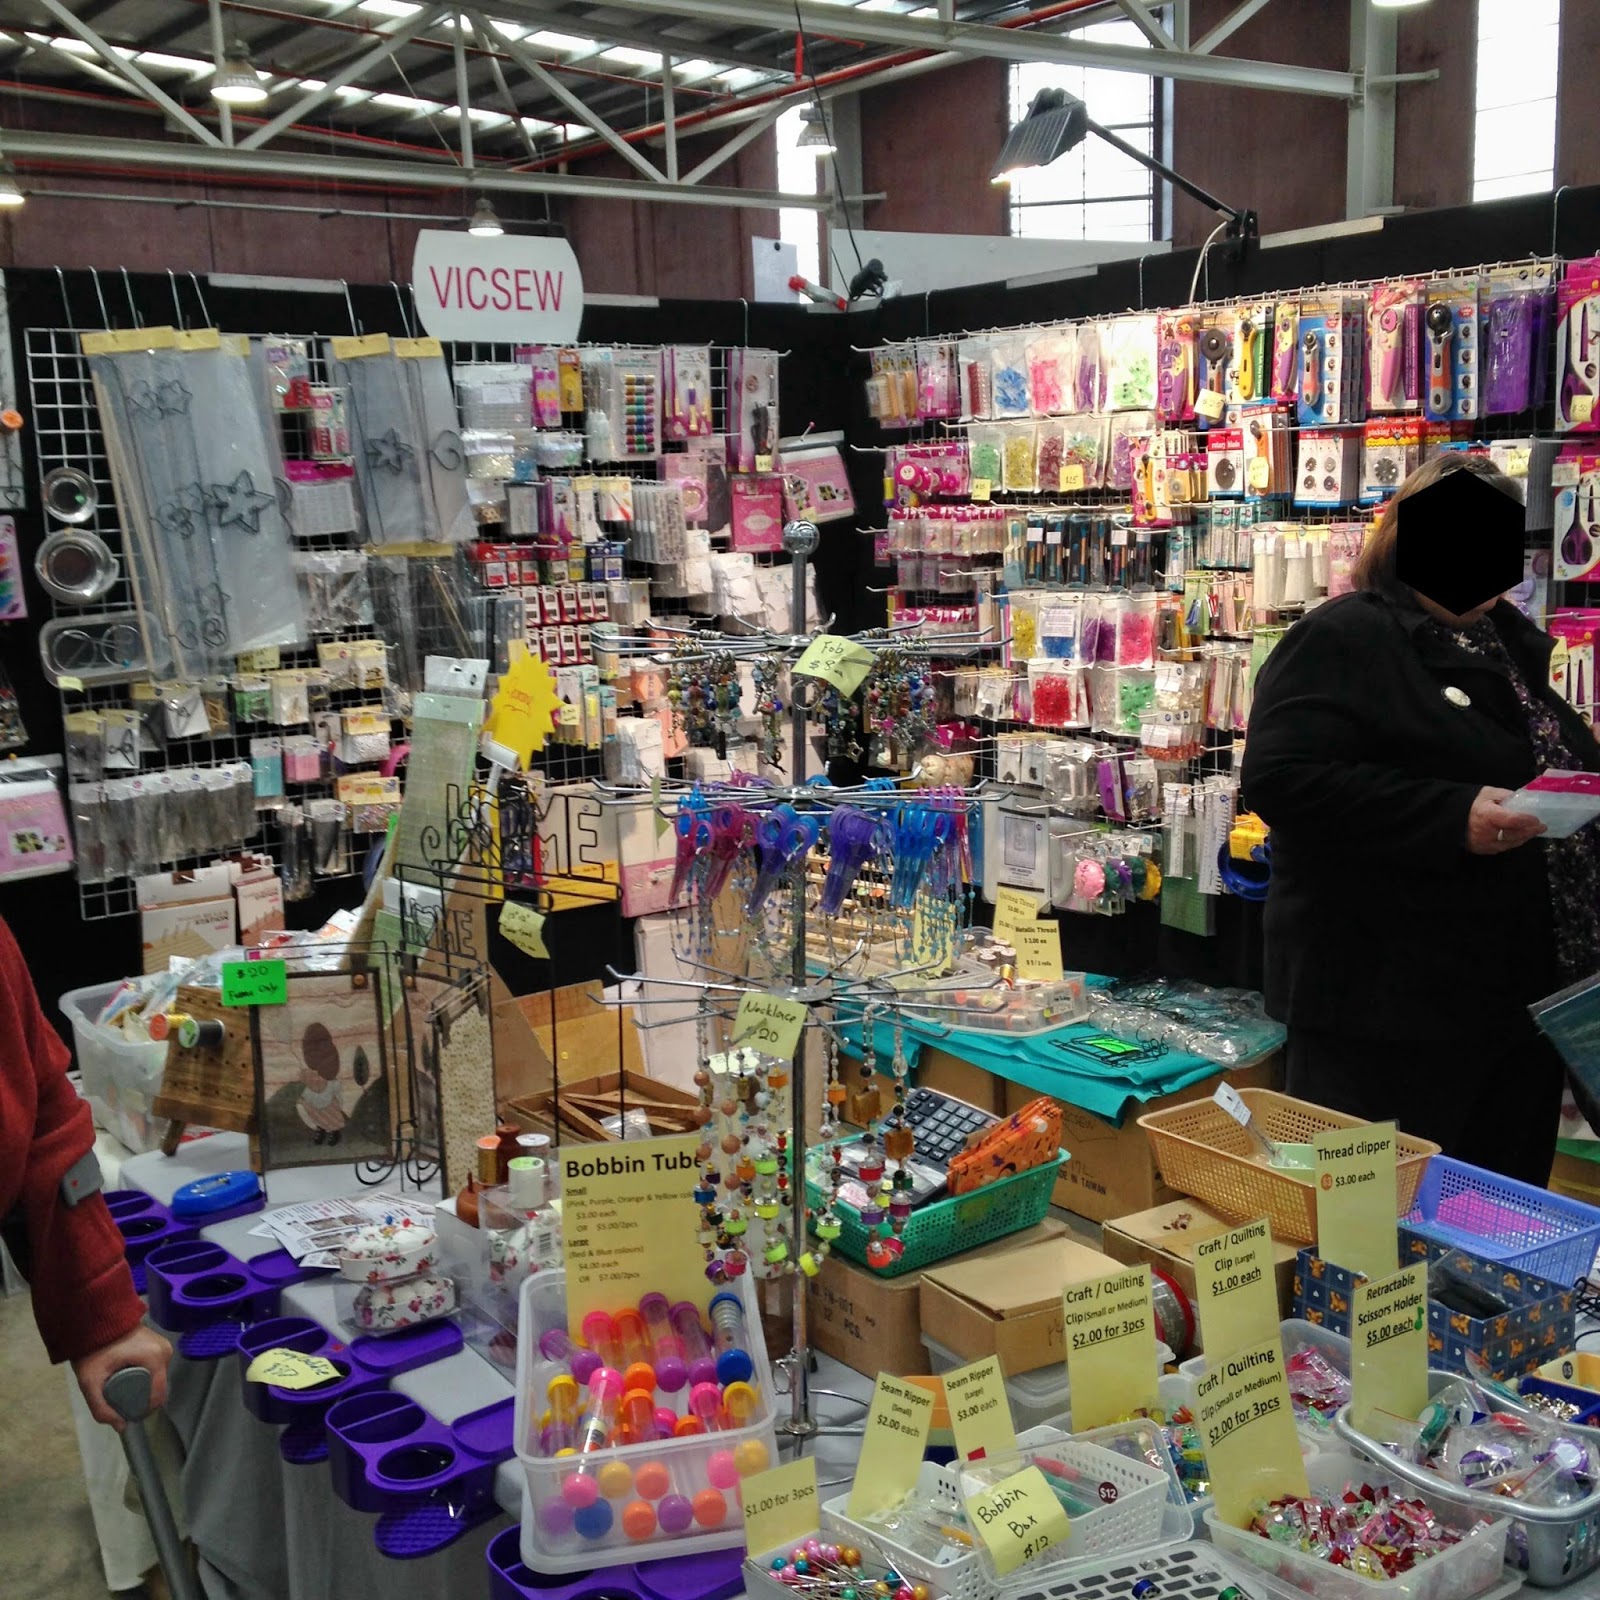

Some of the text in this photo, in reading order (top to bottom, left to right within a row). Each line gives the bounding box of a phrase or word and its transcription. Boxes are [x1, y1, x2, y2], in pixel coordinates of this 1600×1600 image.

[429, 266, 563, 311] VICSEW
[743, 1001, 796, 1023] Necklace
[1317, 1140, 1391, 1161] Thread clipper
[566, 1156, 645, 1178] Bobbin
[1335, 1170, 1376, 1187] $3.00 each
[1198, 1239, 1222, 1256] Craft
[1230, 1225, 1266, 1245] Quilting
[1214, 1250, 1256, 1271] Clip (Large)
[1066, 1286, 1093, 1303] Craft
[1104, 1275, 1145, 1294] Quilting
[1212, 1266, 1261, 1294] $1.00 each
[1366, 1273, 1416, 1300] Retractable
[1107, 1306, 1116, 1315] or
[1117, 1295, 1148, 1311] Medium)
[1358, 1294, 1423, 1326] Scissors Holder
[1072, 1328, 1102, 1349] $2.00
[1104, 1325, 1120, 1338] for
[1122, 1318, 1145, 1334] 3pcs
[1367, 1317, 1413, 1345] $5.00 each
[946, 1366, 993, 1390] Seam Ripper
[1197, 1373, 1219, 1397] Craft
[1227, 1350, 1275, 1376] Quilting
[1234, 1389, 1243, 1398] or
[1244, 1371, 1282, 1393] Medium)
[880, 1381, 930, 1406] Seam Ripper
[957, 1398, 998, 1421] $3.00 each
[1209, 1397, 1280, 1446] $2.00 for 3pcs
[877, 1414, 919, 1438] $2.00 each
[745, 1486, 815, 1518] $1.00 for 3pcs
[977, 1489, 1028, 1524] Bobbin
[1099, 1487, 1117, 1499] $12
[1007, 1515, 1038, 1538] Box
